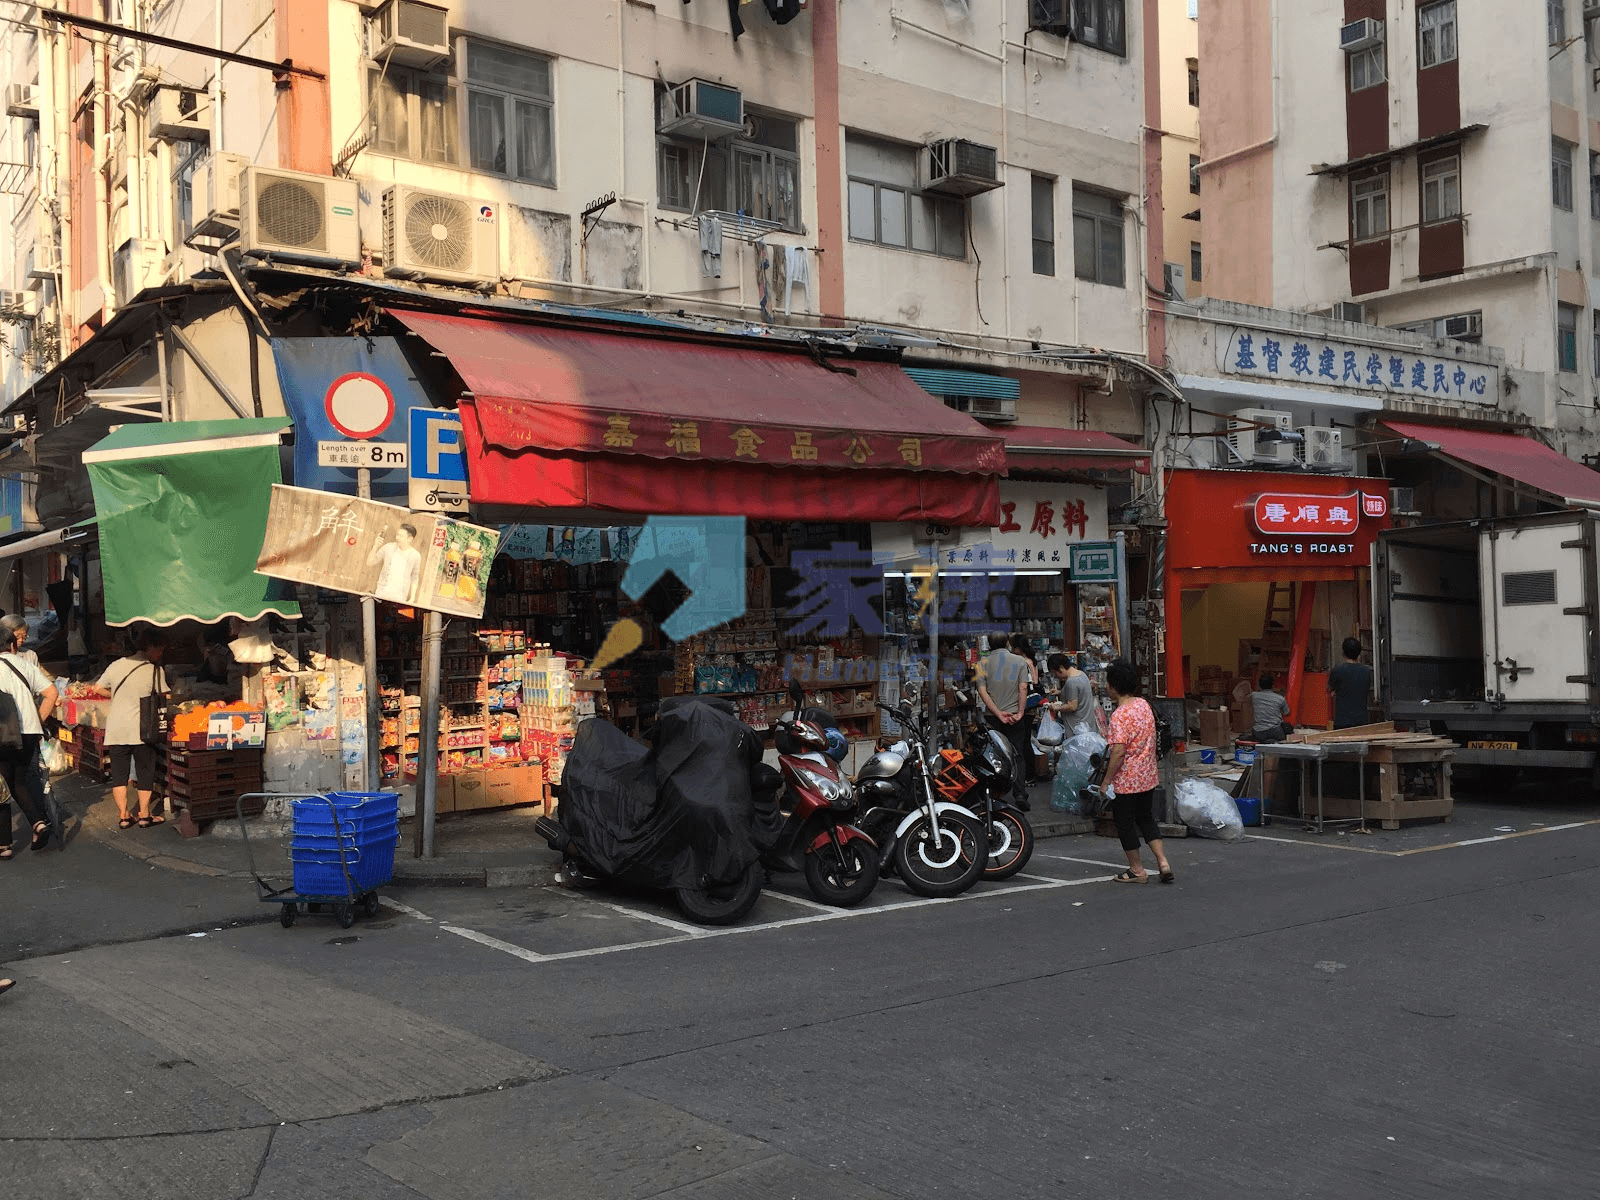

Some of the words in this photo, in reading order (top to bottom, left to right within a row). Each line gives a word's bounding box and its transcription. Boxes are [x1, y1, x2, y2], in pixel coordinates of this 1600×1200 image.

[1234, 333, 1487, 396] 基督教建民堂暨建民中心
[321, 444, 348, 453] Length
[426, 417, 466, 475] P
[603, 412, 923, 467] 嘉福食品公司
[328, 454, 360, 464] 車長逾
[998, 498, 1090, 540] 工原料
[1261, 502, 1354, 526] 唐順興
[1250, 543, 1303, 554] TANG'S
[1309, 543, 1355, 554] ROAST
